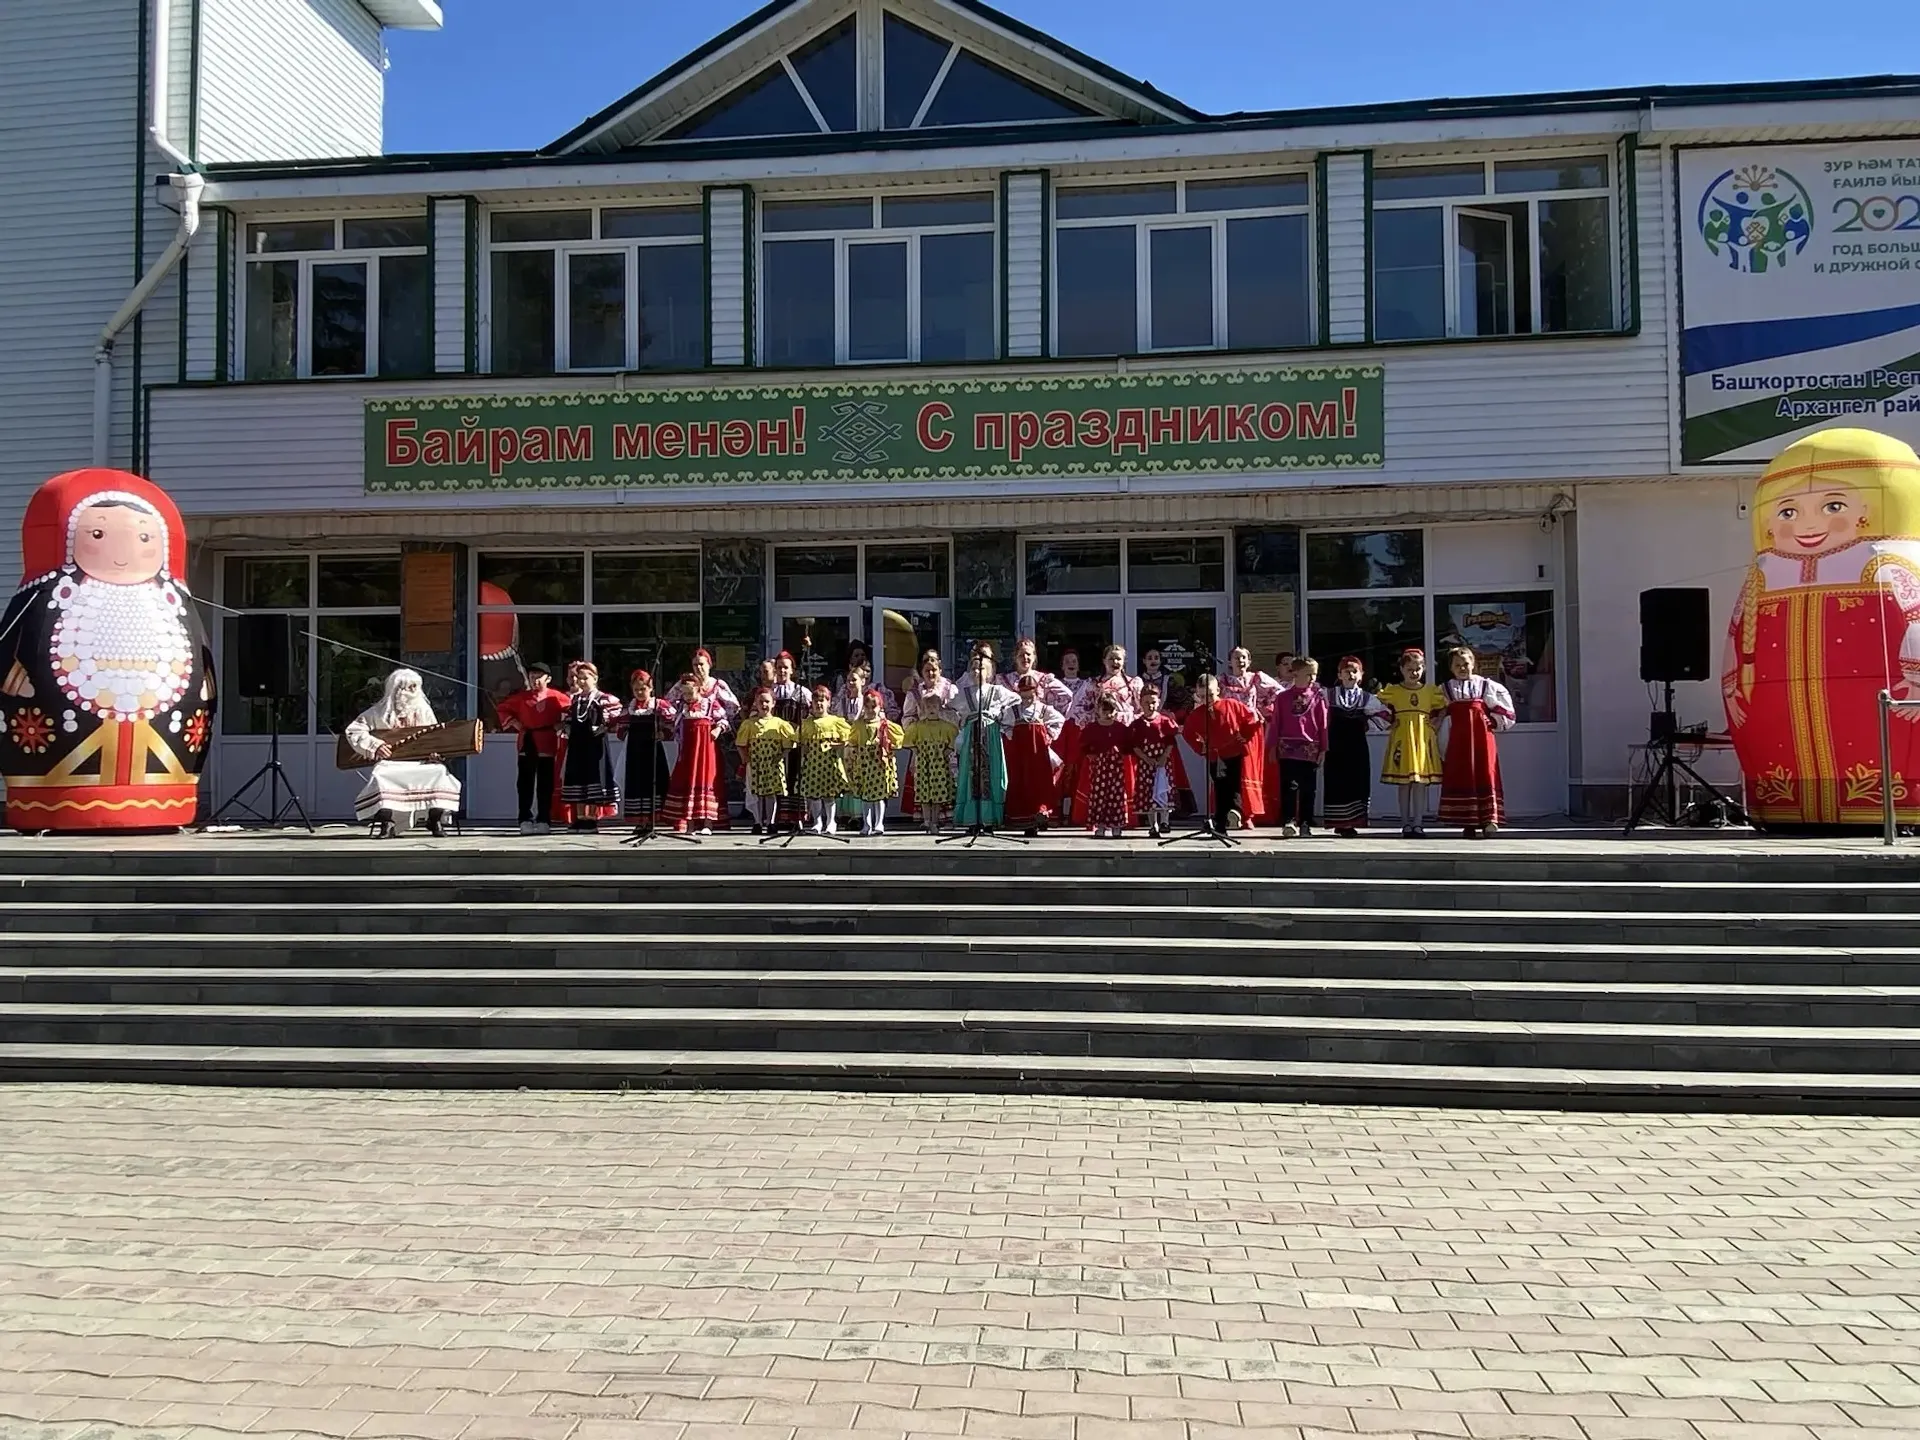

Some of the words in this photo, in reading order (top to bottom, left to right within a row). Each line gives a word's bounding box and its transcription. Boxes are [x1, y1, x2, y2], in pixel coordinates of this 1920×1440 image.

[1833, 244, 1863, 256] ГОД
[1814, 263, 1824, 273] И
[1829, 258, 1910, 274] ДРУЖНОЙ
[1873, 369, 1920, 387] Респ
[1777, 398, 1876, 417] Архангел
[1883, 395, 1920, 417] рай
[386, 416, 593, 476] Байрам
[613, 406, 806, 460] менән!
[917, 401, 955, 452] С
[974, 387, 1358, 462] праздником!
